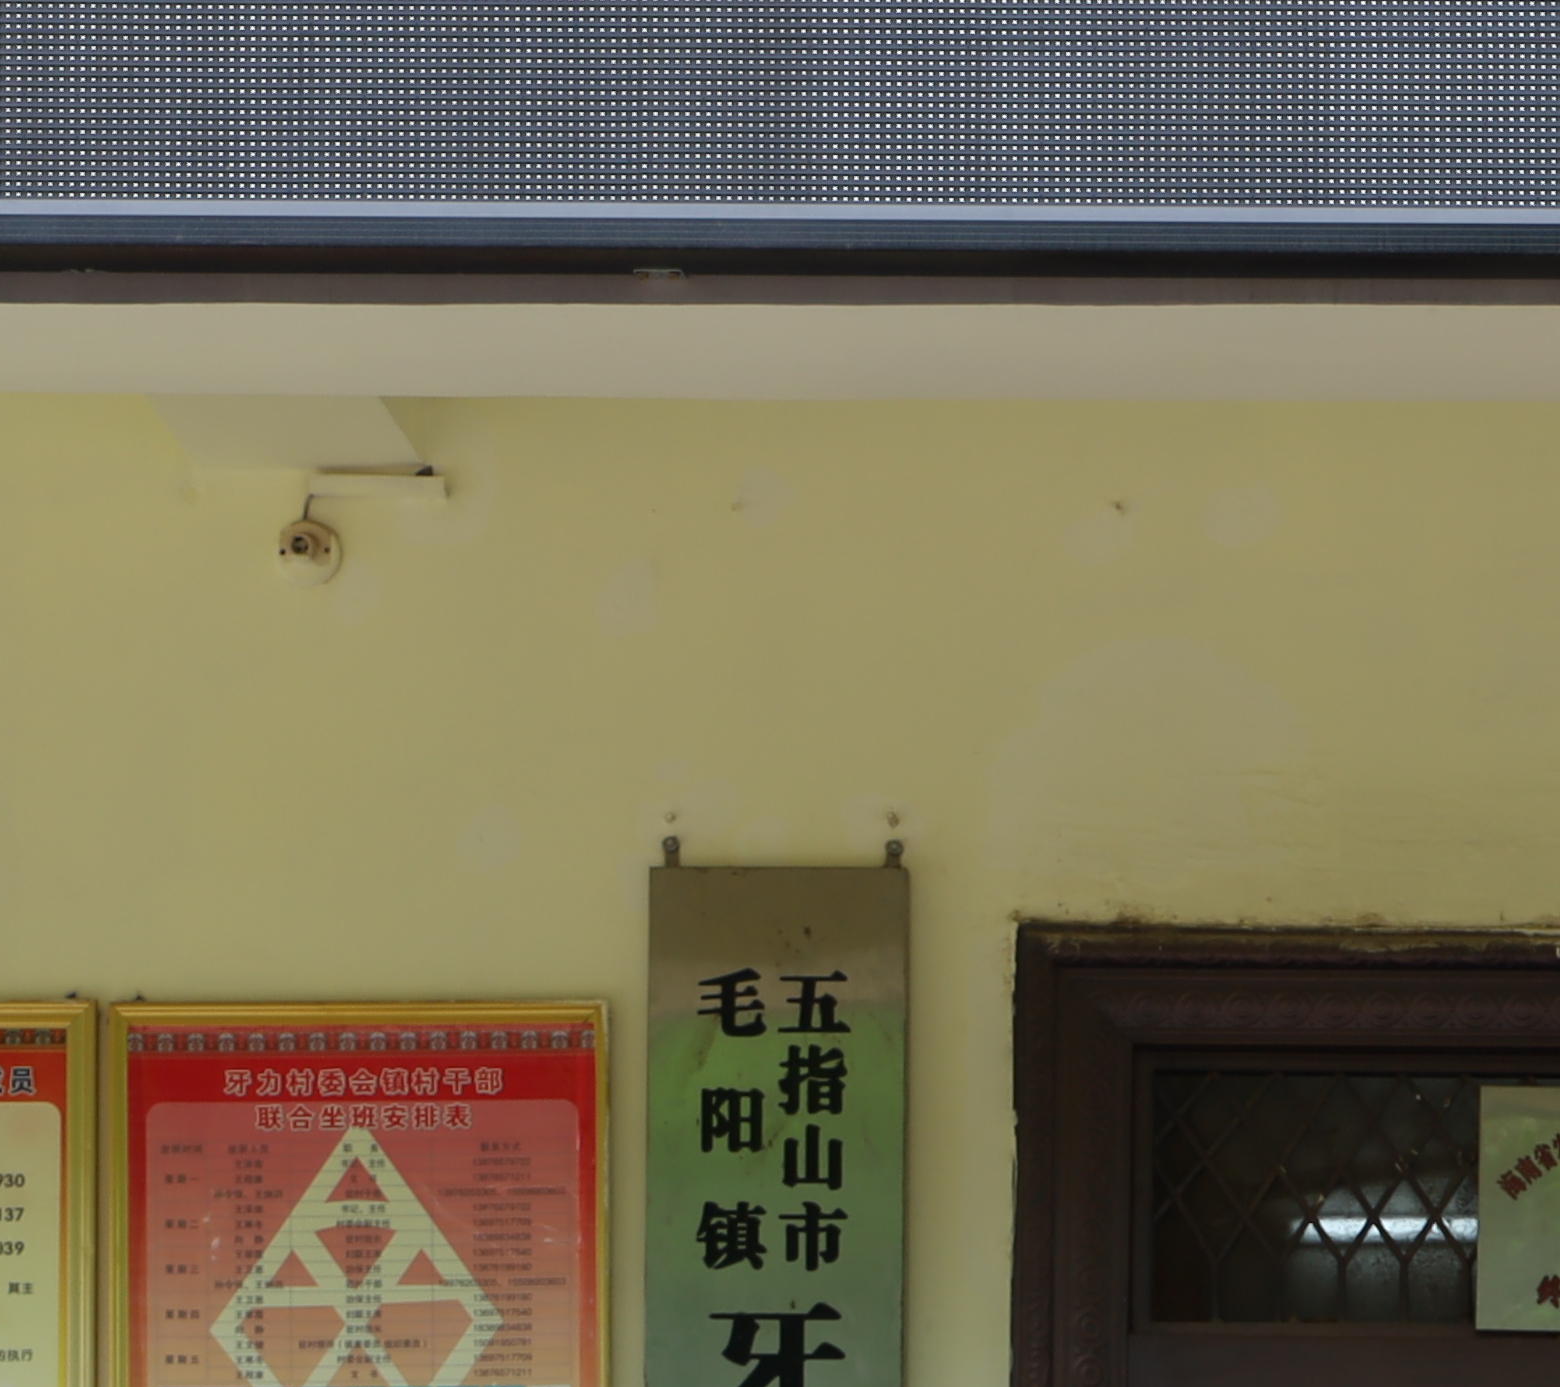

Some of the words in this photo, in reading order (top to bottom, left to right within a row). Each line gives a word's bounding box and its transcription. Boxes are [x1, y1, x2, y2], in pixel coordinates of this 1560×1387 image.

[223, 1067, 504, 1096] 牙力村委会镇村干部
[255, 1104, 472, 1131] 联合坐班安排表
[696, 968, 768, 1271] 毛阳镇
[778, 970, 851, 1271] 五指山市
